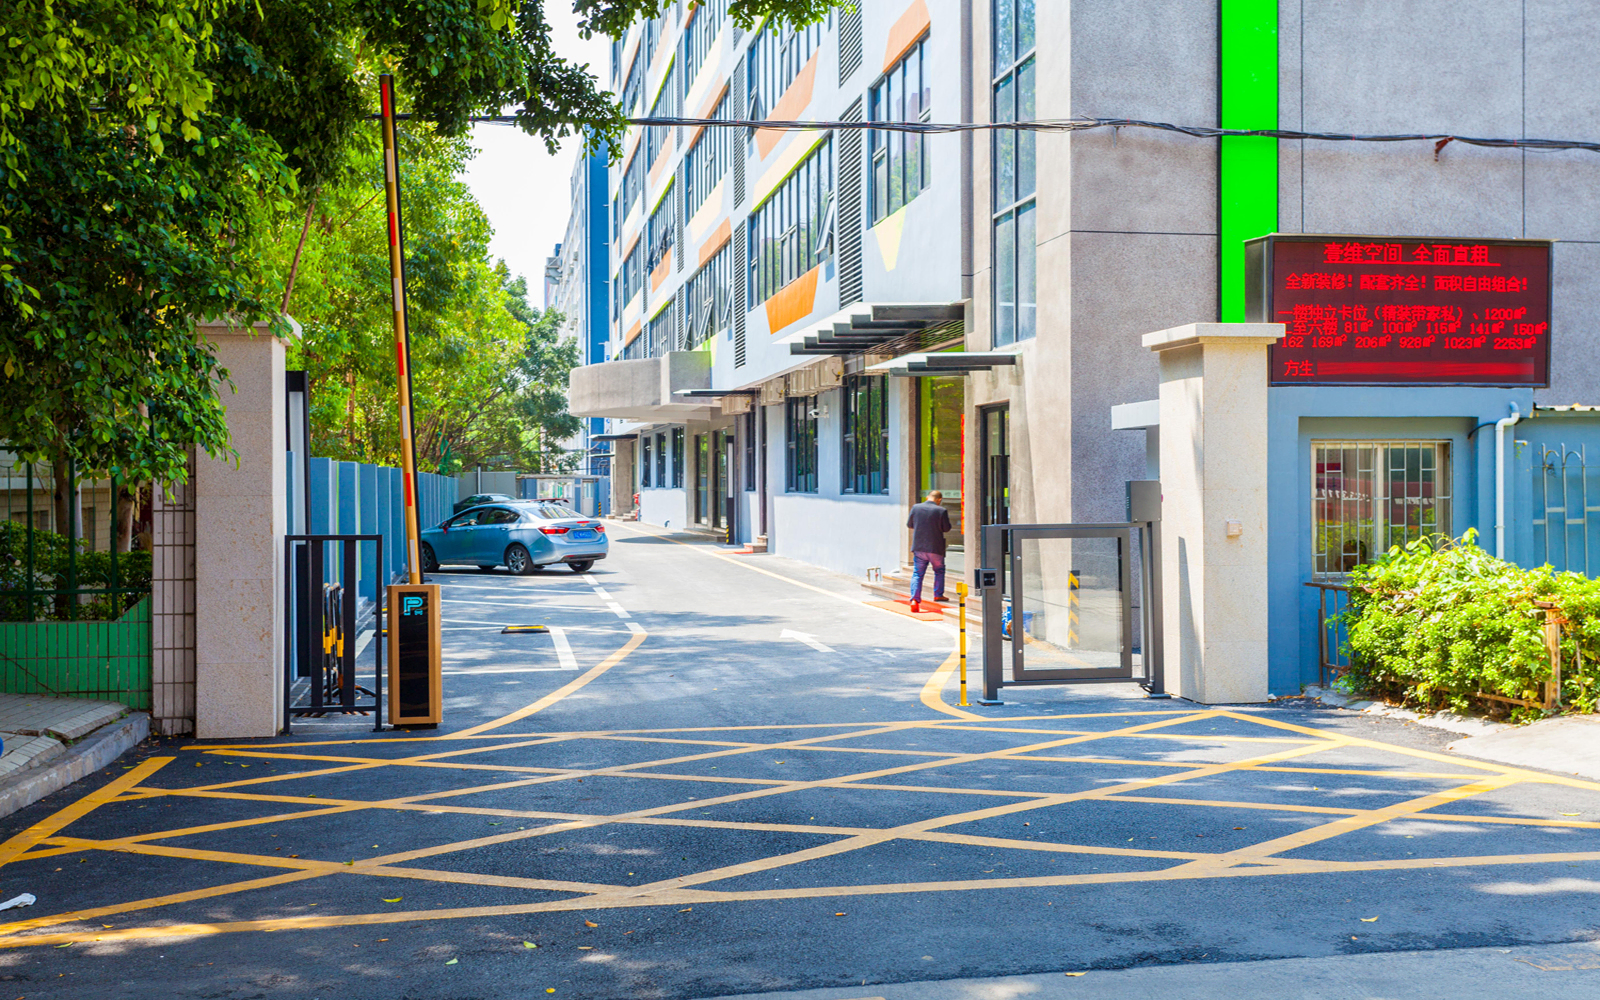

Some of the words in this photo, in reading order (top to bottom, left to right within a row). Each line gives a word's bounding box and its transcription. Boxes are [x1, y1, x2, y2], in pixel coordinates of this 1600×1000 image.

[1323, 242, 1402, 262] 壹维空间
[1412, 243, 1489, 265] 全面直租
[1281, 336, 1304, 348] 162
[1284, 360, 1314, 376] 方生
